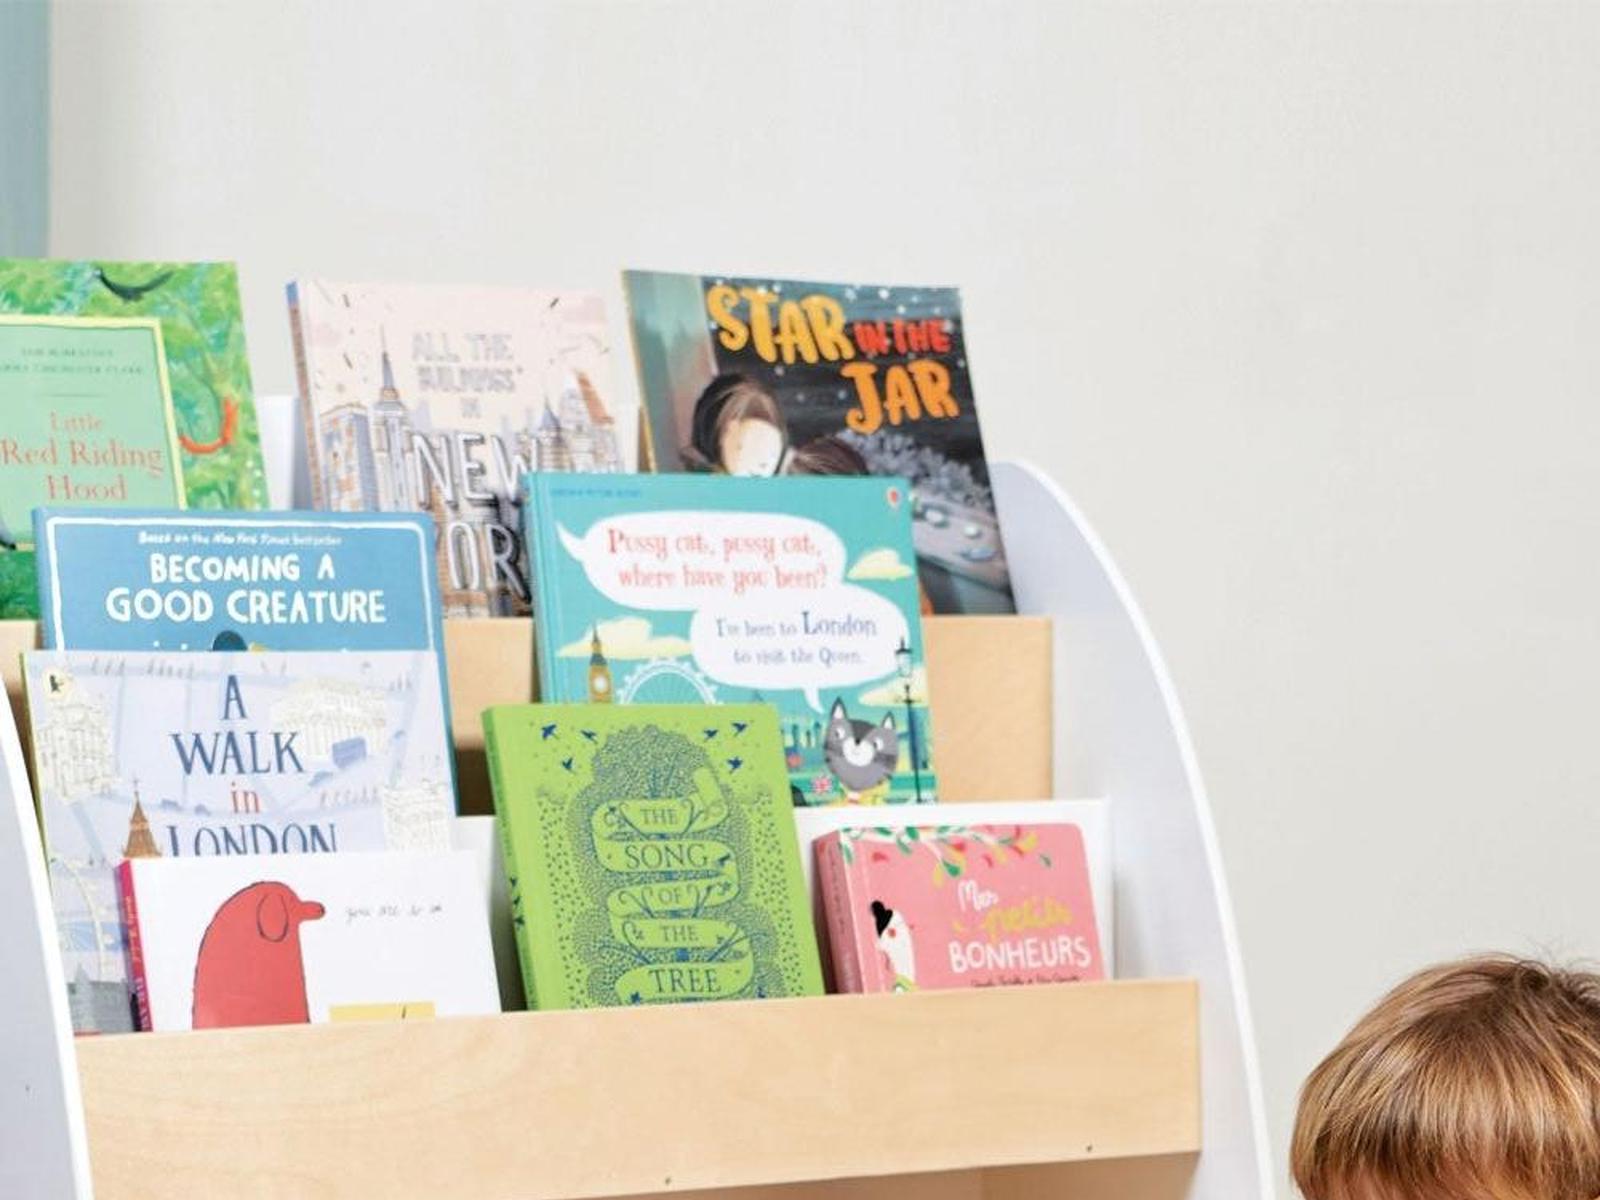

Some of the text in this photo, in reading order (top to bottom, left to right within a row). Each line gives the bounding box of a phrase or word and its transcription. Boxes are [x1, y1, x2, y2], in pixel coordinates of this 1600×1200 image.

[706, 284, 952, 364] STAR IN THE
[841, 359, 960, 435] JAR
[0, 437, 163, 478] Red Riding
[411, 431, 540, 506] NEW
[47, 472, 128, 501] Hood
[608, 529, 668, 559] Pussy
[723, 532, 776, 562] pussy
[150, 552, 336, 584] BECOMING A
[618, 562, 828, 594] where have you been?
[105, 586, 387, 625] GOOD CREATURE
[744, 618, 775, 637] been
[779, 619, 798, 636] to
[802, 611, 879, 637] London
[733, 648, 752, 664] to
[790, 648, 814, 665] the
[219, 673, 249, 721] A
[170, 729, 306, 775] WALK
[229, 781, 261, 815] in
[638, 808, 679, 826] THE
[165, 822, 338, 858] LONDON
[623, 843, 709, 870] SONG
[657, 887, 683, 905] OF
[659, 925, 700, 943] THE
[947, 935, 1092, 974] BONHEURS
[648, 968, 722, 994] TREE
